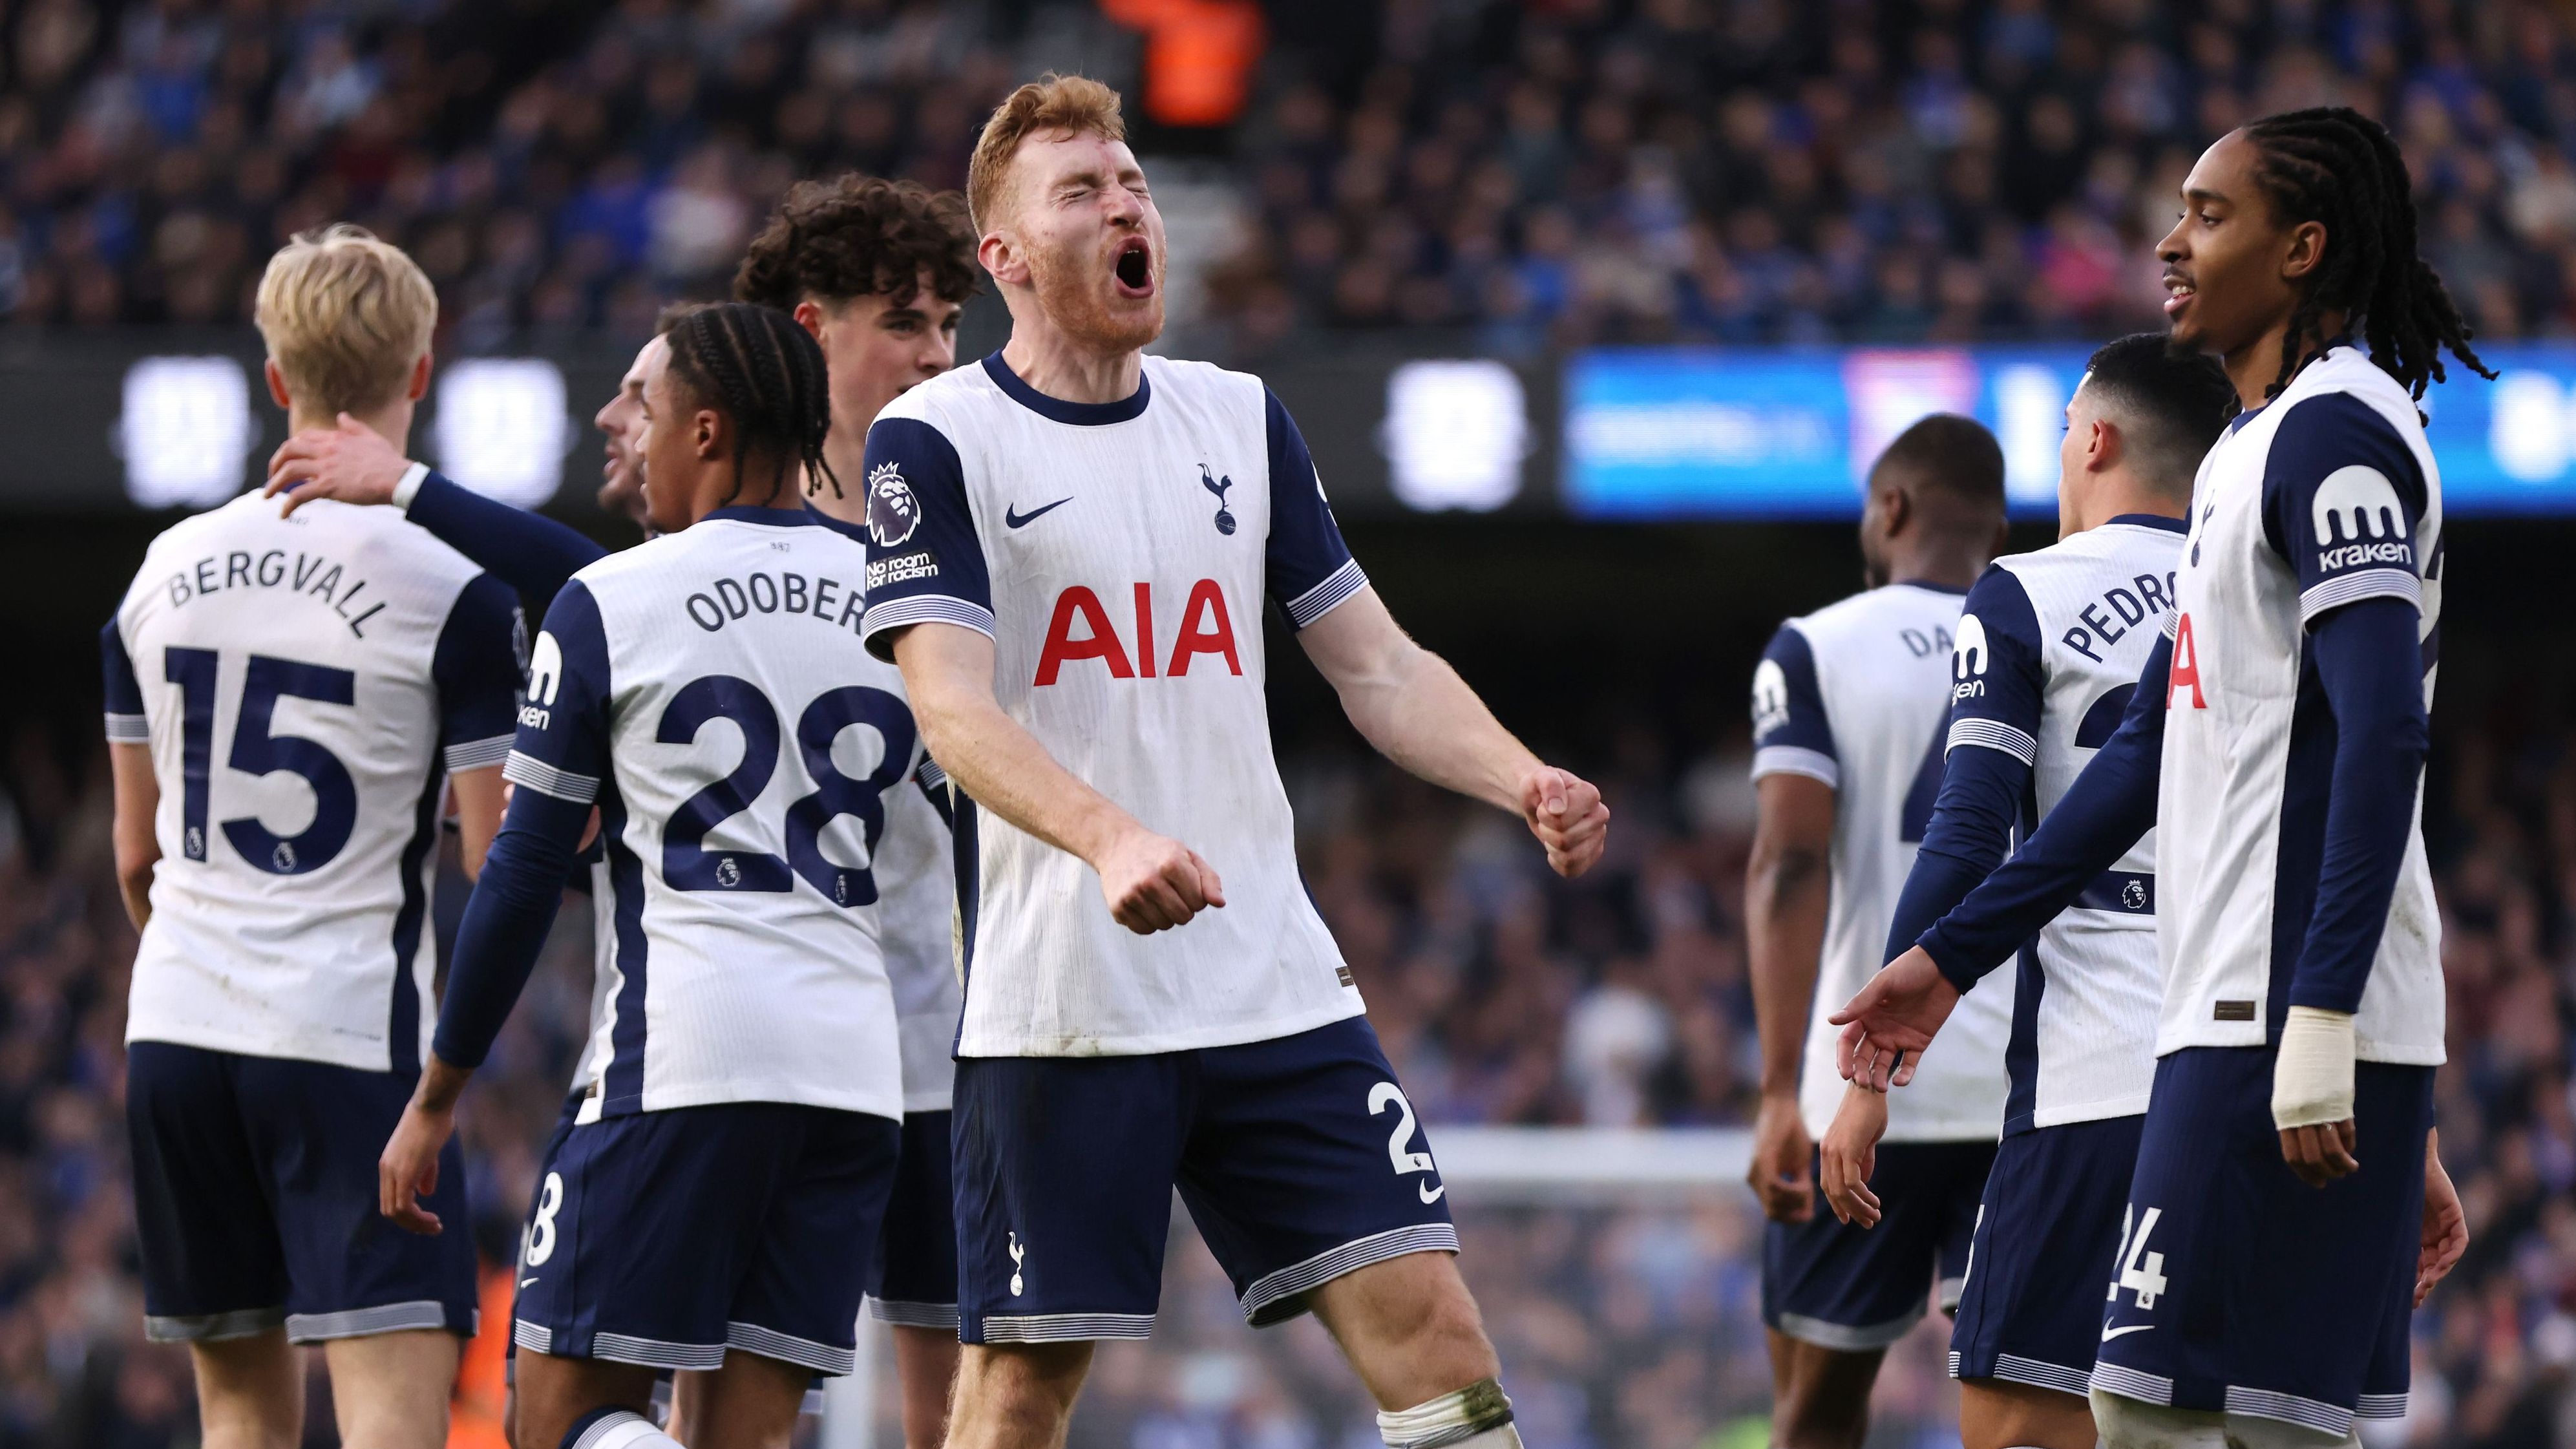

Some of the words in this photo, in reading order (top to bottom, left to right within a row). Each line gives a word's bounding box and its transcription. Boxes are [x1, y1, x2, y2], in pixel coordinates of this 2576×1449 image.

[168, 549, 386, 639] BERGVALL
[866, 561, 887, 578] No
[889, 553, 930, 571] room
[867, 574, 886, 591] for
[888, 564, 939, 584] racism
[2319, 542, 2412, 573] kraken
[686, 572, 866, 637] ODOBER
[1034, 578, 1243, 686] AIA
[164, 646, 357, 876] 15
[657, 674, 916, 908] 28
[1367, 1081, 1435, 1175] 2
